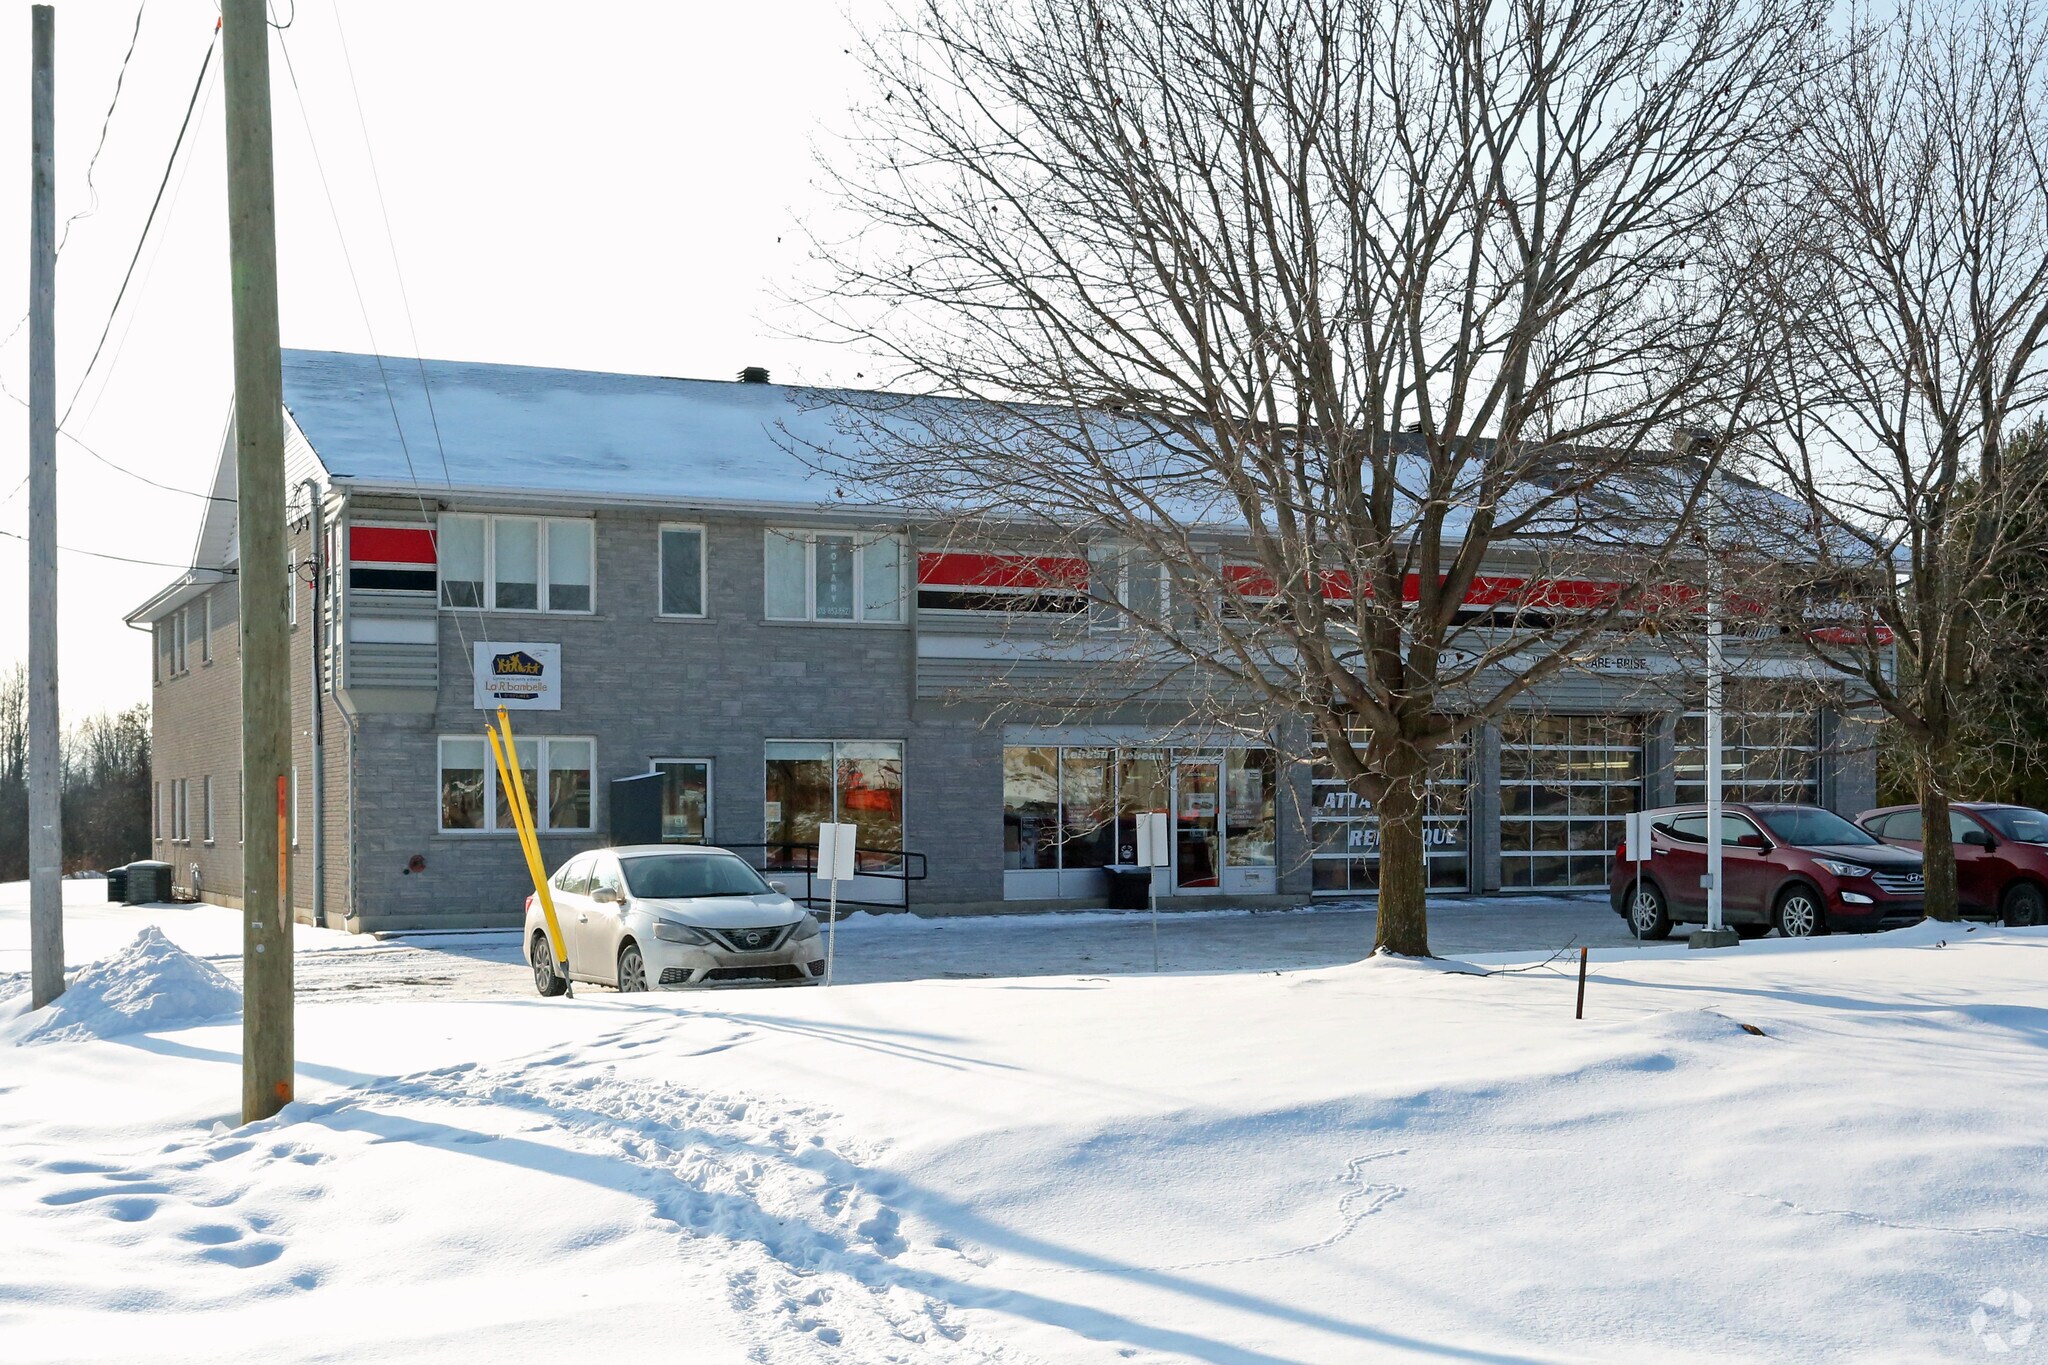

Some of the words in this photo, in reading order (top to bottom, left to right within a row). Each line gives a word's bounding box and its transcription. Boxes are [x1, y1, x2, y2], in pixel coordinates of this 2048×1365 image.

[485, 681, 497, 691] La
[499, 681, 548, 691] Rbambelle
[1350, 828, 1457, 846] REQUE
